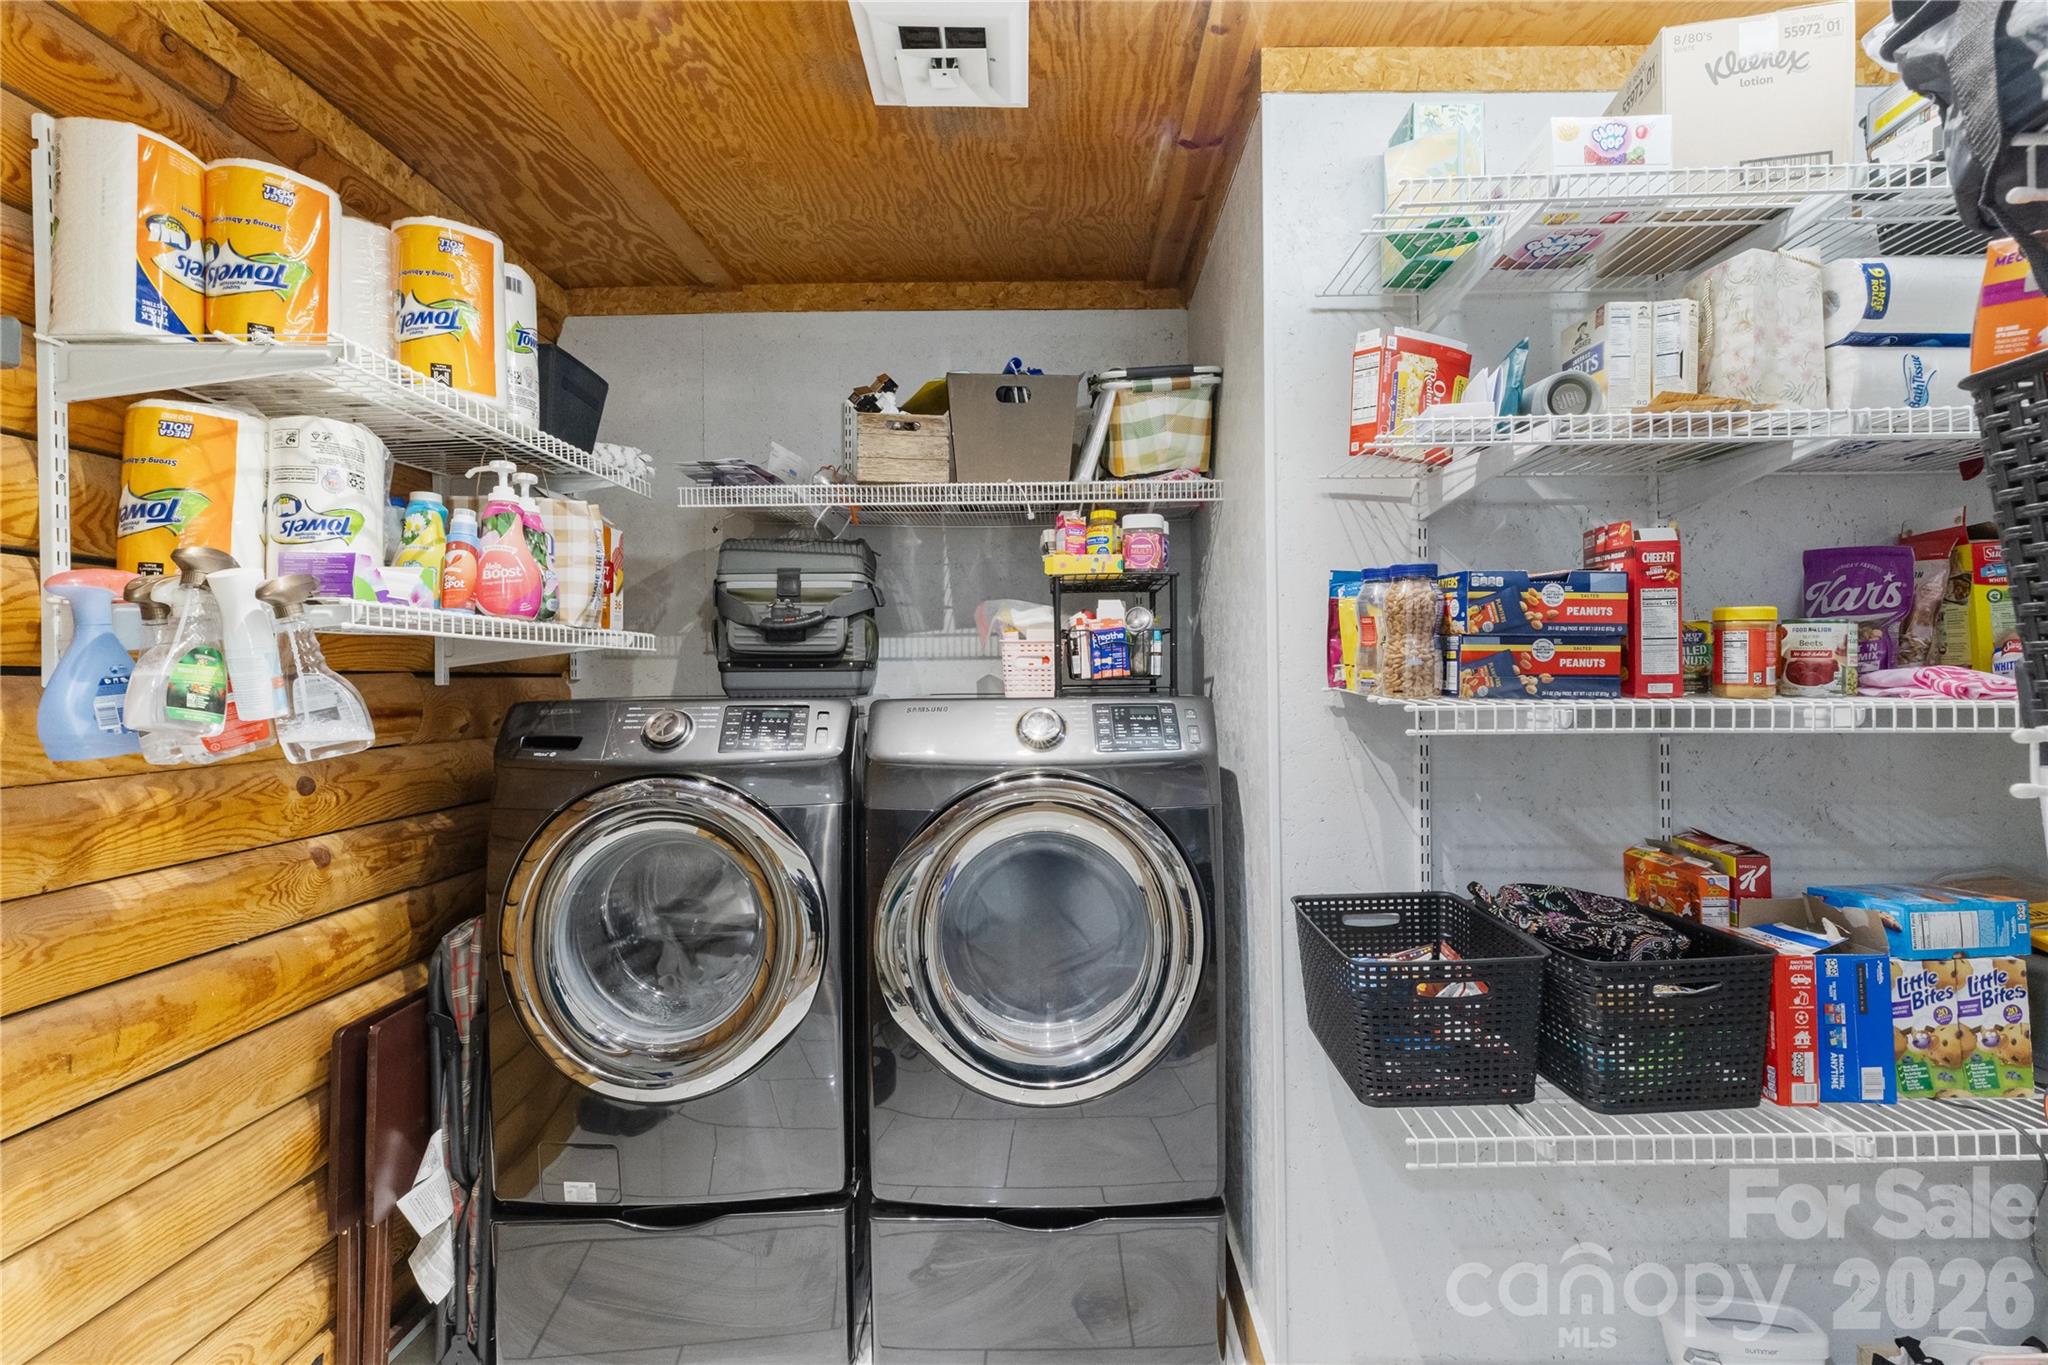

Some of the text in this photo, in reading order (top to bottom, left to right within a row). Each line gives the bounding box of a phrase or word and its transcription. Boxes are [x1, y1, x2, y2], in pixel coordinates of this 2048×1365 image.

[1784, 19, 1842, 40] 55972 01
[1673, 31, 1713, 47] 8/80's
[1705, 50, 1810, 87] Kleenex
[1739, 73, 1775, 88] lotion
[1591, 122, 1628, 143] BLOW
[1599, 136, 1625, 151] POP
[253, 218, 283, 232] Strong
[208, 263, 290, 290] Towels
[1870, 279, 1880, 307] ROLLS
[1878, 279, 1887, 313] LARGE
[400, 309, 462, 334] Towel
[1575, 353, 1600, 373] RITS
[159, 421, 193, 432] ROLL
[159, 428, 191, 439] MEGA
[148, 457, 177, 467] Strong
[279, 516, 352, 537] Towels
[1641, 551, 1676, 564] CHEEZ-IT
[1566, 606, 1613, 617] PEANUTS
[1799, 640, 1824, 648] Beets
[1559, 657, 1606, 668] PEANUTS
[1994, 661, 2016, 671] WHIT
[1738, 865, 1768, 893] K
[1897, 970, 1938, 999] Little
[1967, 969, 2007, 997] Little
[1912, 986, 1954, 1010] Bites
[1982, 986, 2026, 1009] Bites
[1936, 1008, 1949, 1017] 20
[2006, 1007, 2018, 1016] 20
[1830, 1052, 1840, 1090] ANYTIME
[1744, 1347, 1779, 1355] summer
